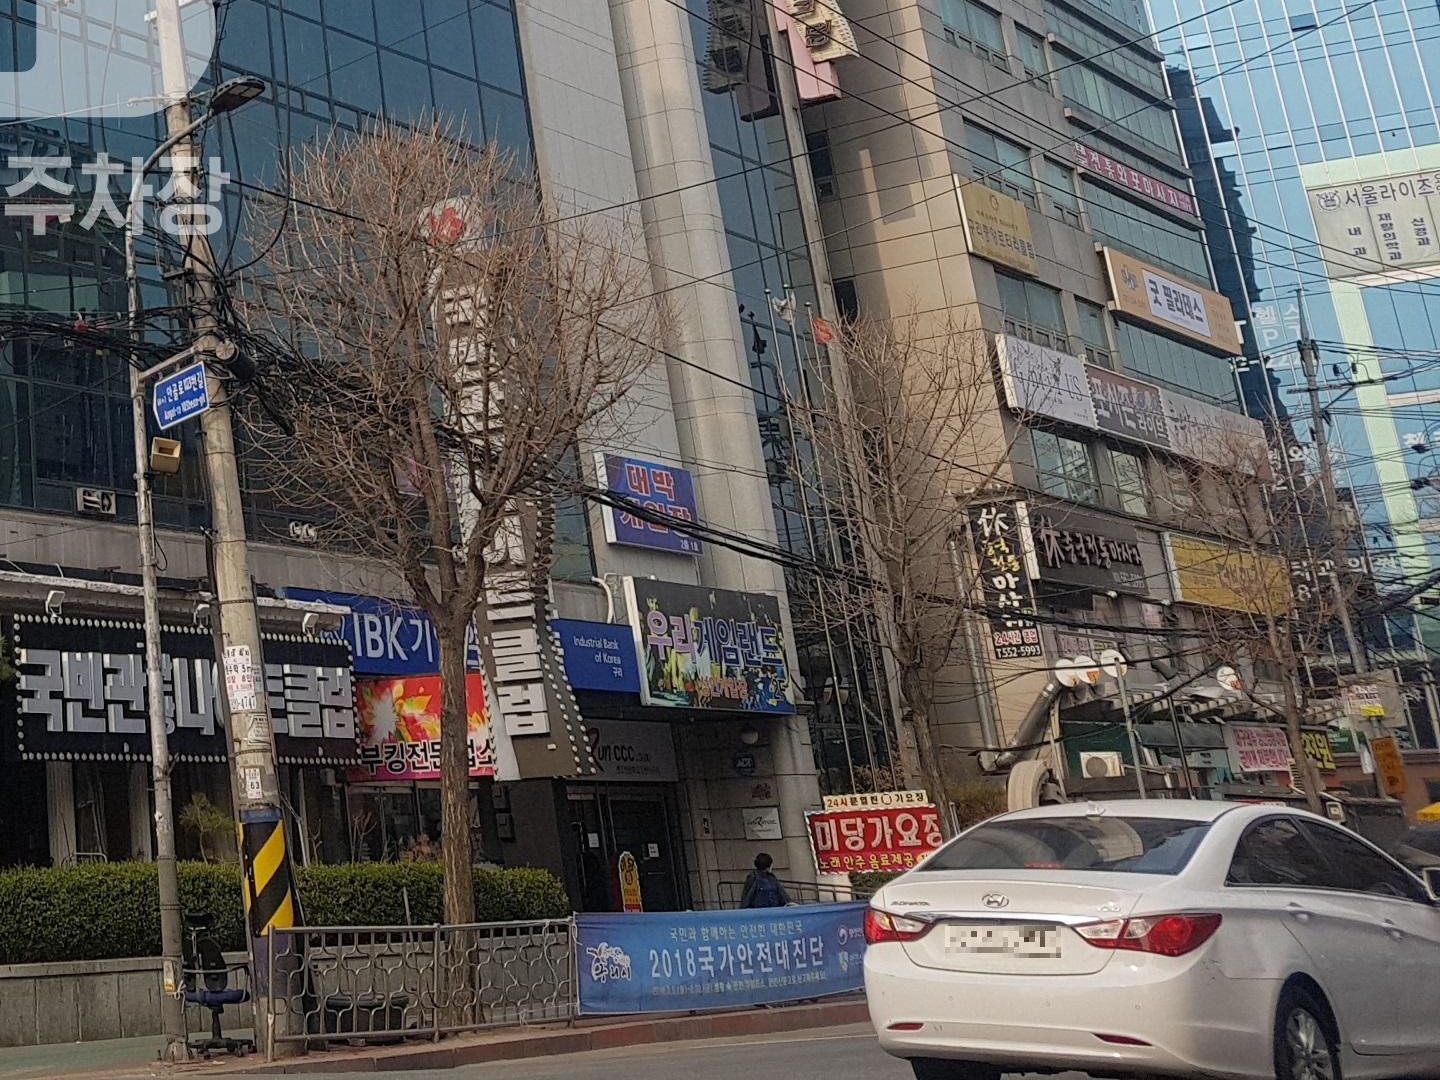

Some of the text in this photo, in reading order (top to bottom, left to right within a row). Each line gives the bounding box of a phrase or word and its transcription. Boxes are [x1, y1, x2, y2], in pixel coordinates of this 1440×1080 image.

[573, 635, 620, 651] Industrial Bank
[20, 649, 147, 732] 국빈관
[769, 918, 804, 936] 대한민국
